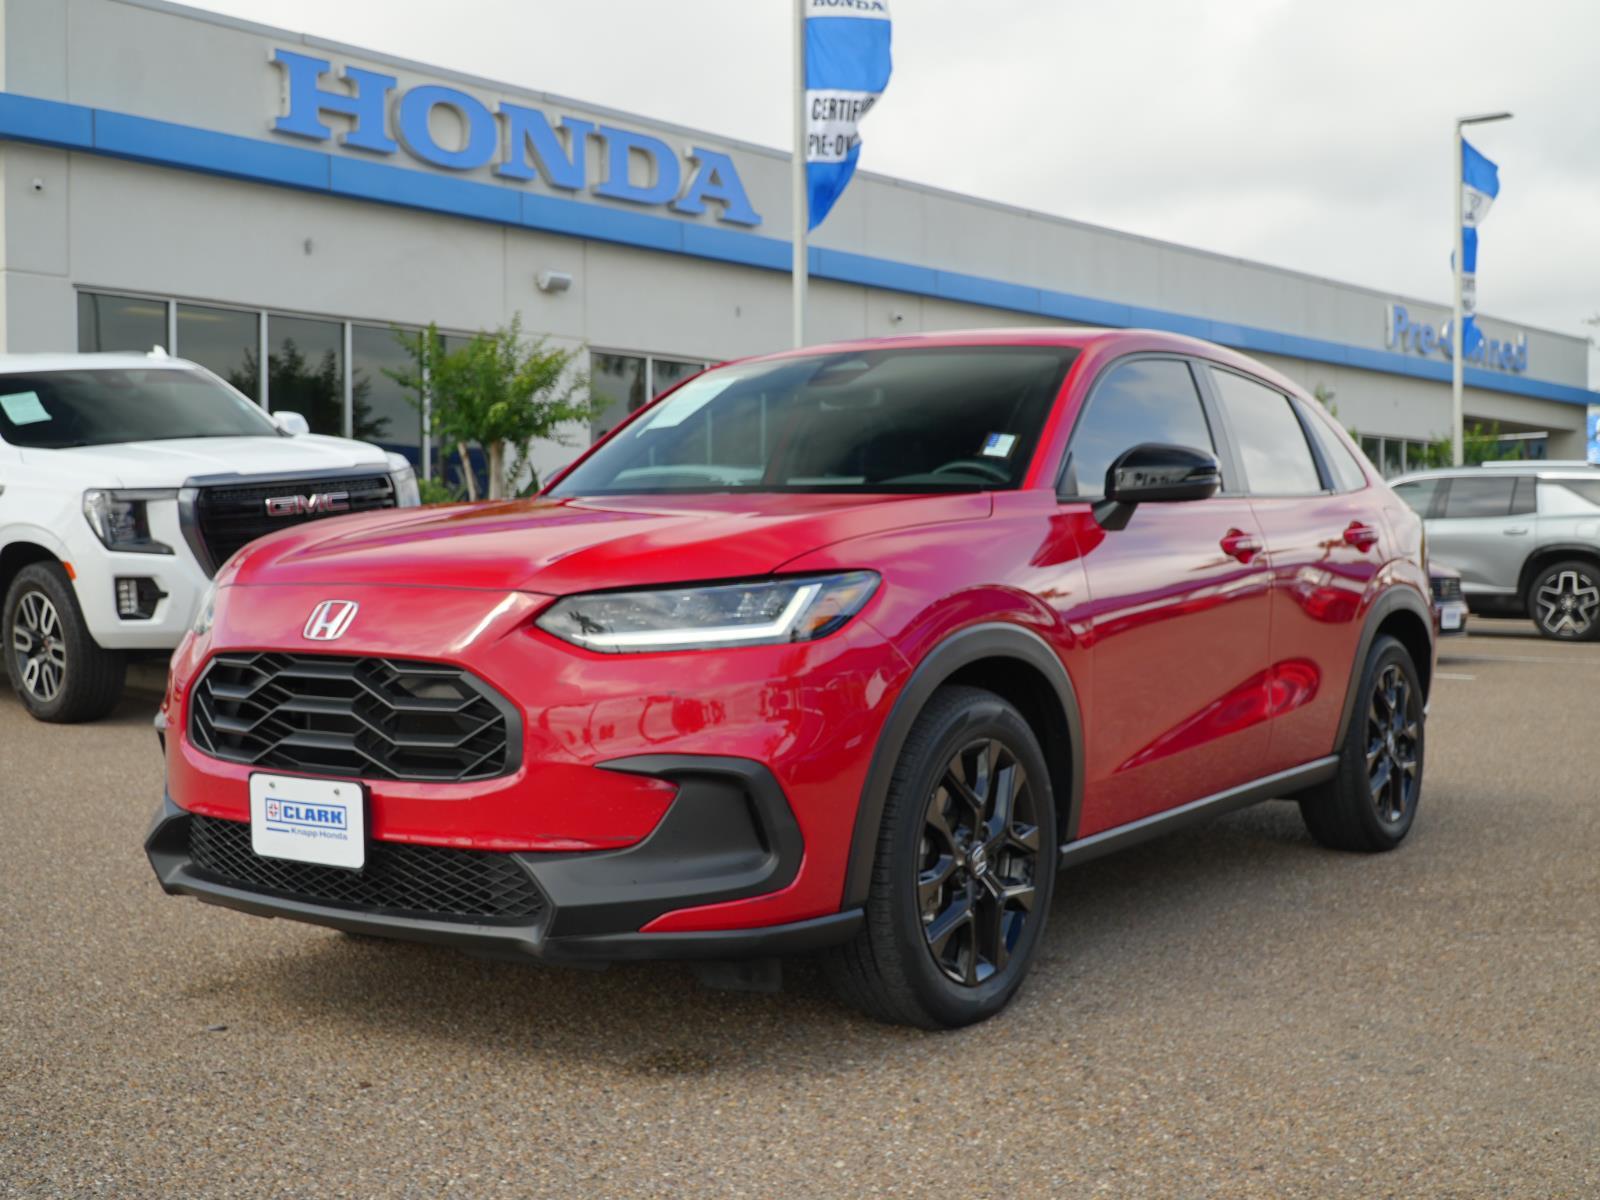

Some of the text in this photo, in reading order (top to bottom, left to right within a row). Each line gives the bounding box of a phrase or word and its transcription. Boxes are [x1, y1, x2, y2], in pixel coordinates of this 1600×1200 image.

[812, 97, 875, 121] CERTIF
[270, 48, 762, 227] HONDA
[265, 491, 350, 516] GMC
[283, 805, 343, 824] CLARK
[290, 827, 349, 841] Knapp Honda
